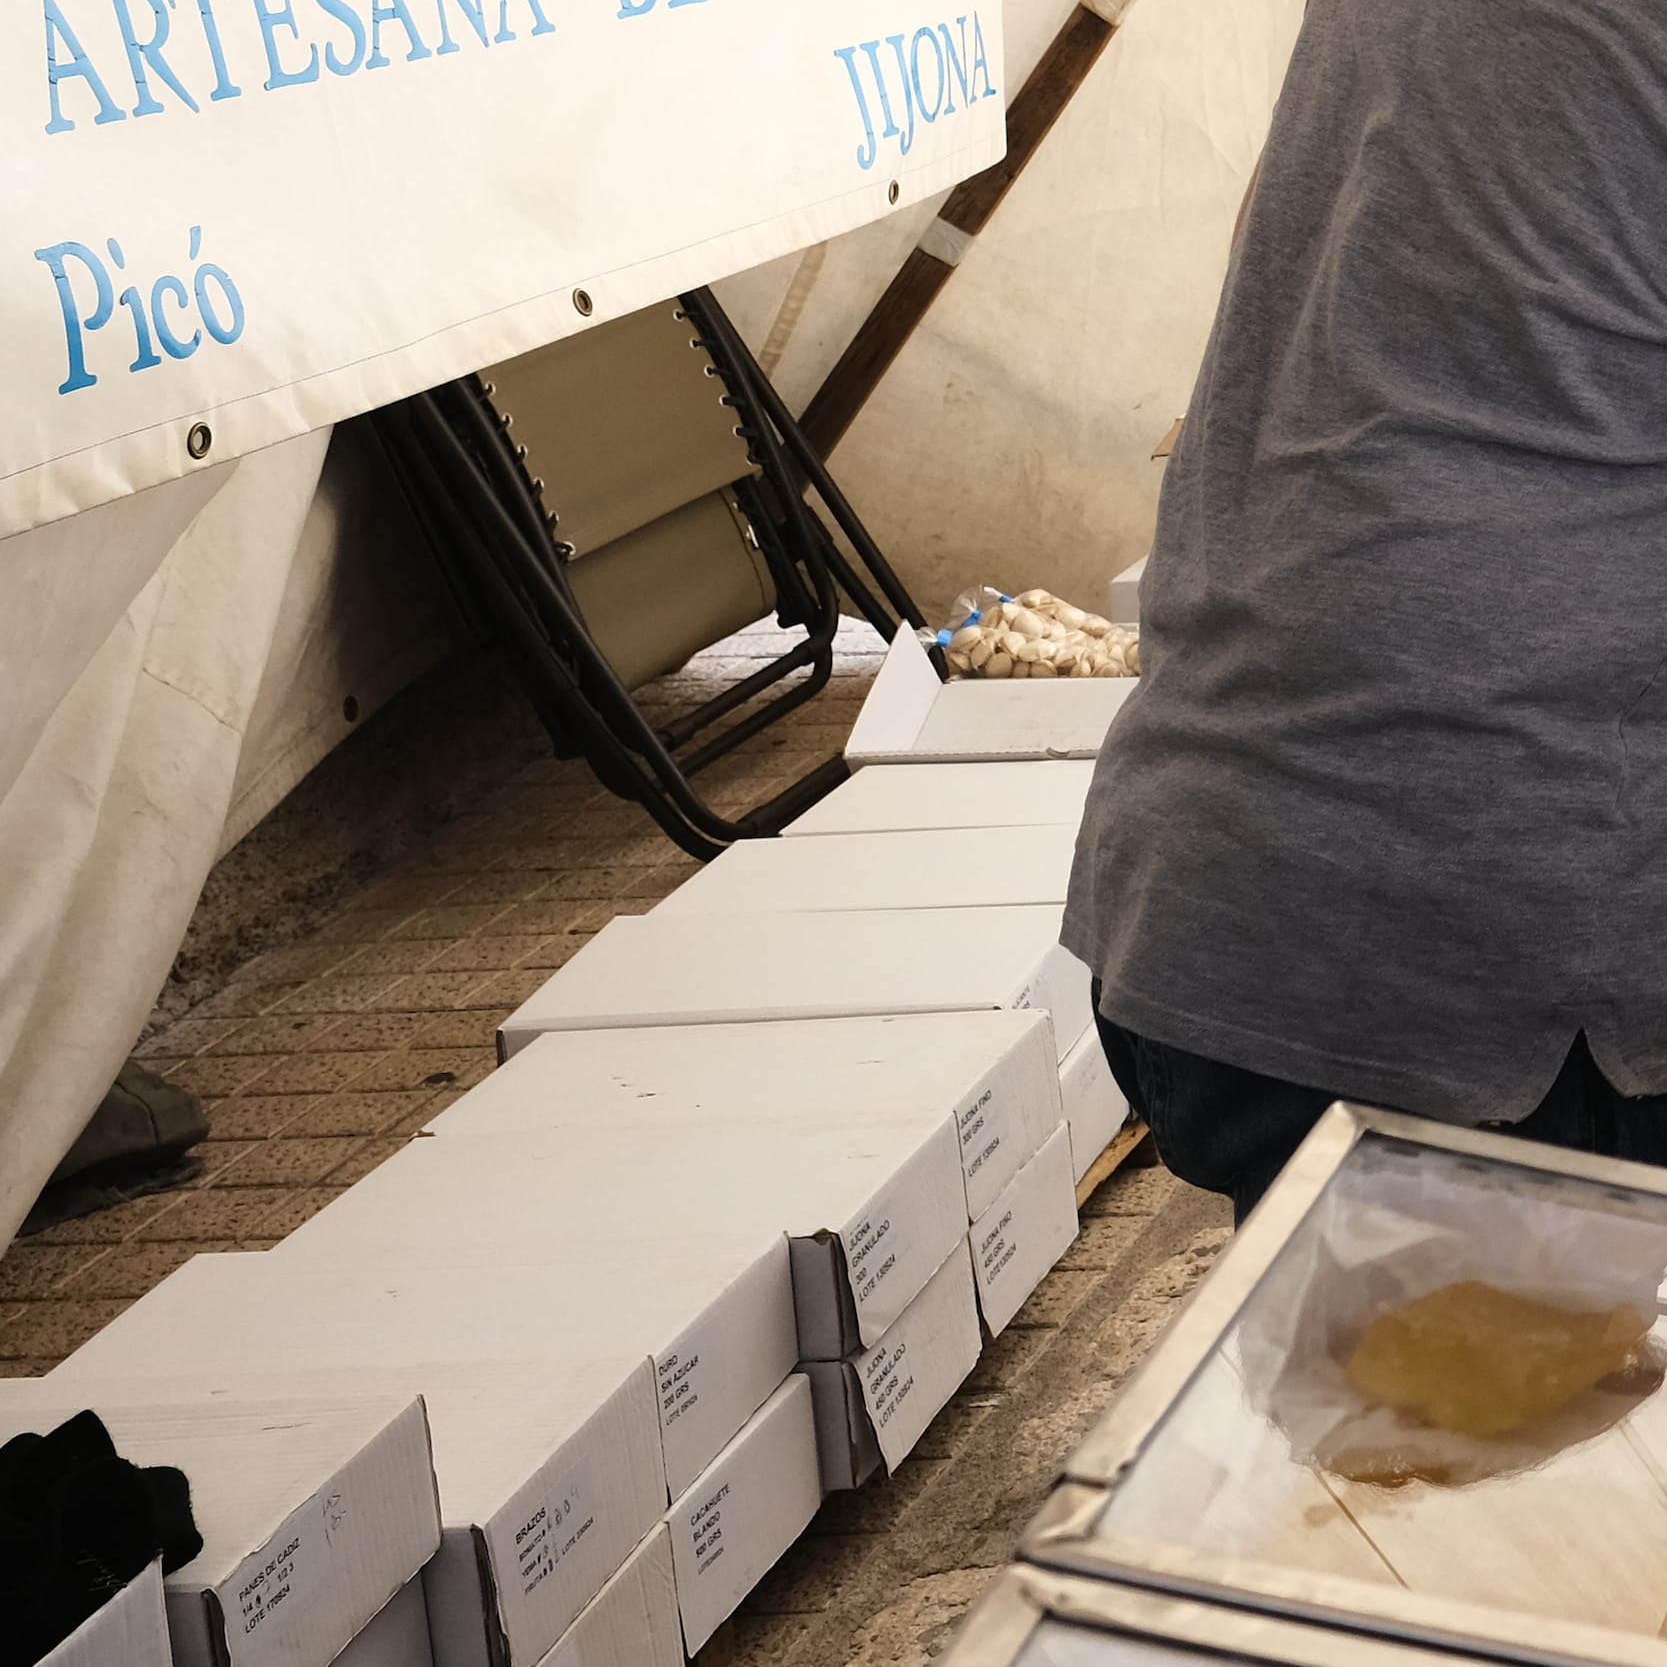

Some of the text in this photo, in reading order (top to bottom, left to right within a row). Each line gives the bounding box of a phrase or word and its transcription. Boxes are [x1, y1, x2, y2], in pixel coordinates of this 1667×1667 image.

[834, 11, 998, 172] JIJONA
[34, 225, 246, 394] Picó
[852, 1220, 890, 1268] GRANULADO
[658, 1354, 678, 1376] DURO
[673, 1356, 700, 1383] AZUCAR
[870, 1343, 906, 1395] GRANULADO
[516, 1507, 546, 1545] BRAZOS
[691, 1484, 730, 1526] CACAHUETE
[693, 1511, 720, 1543] BLANDO
[239, 1537, 301, 1602] PANES DE CADIZ
[245, 1611, 265, 1634] LOTE
